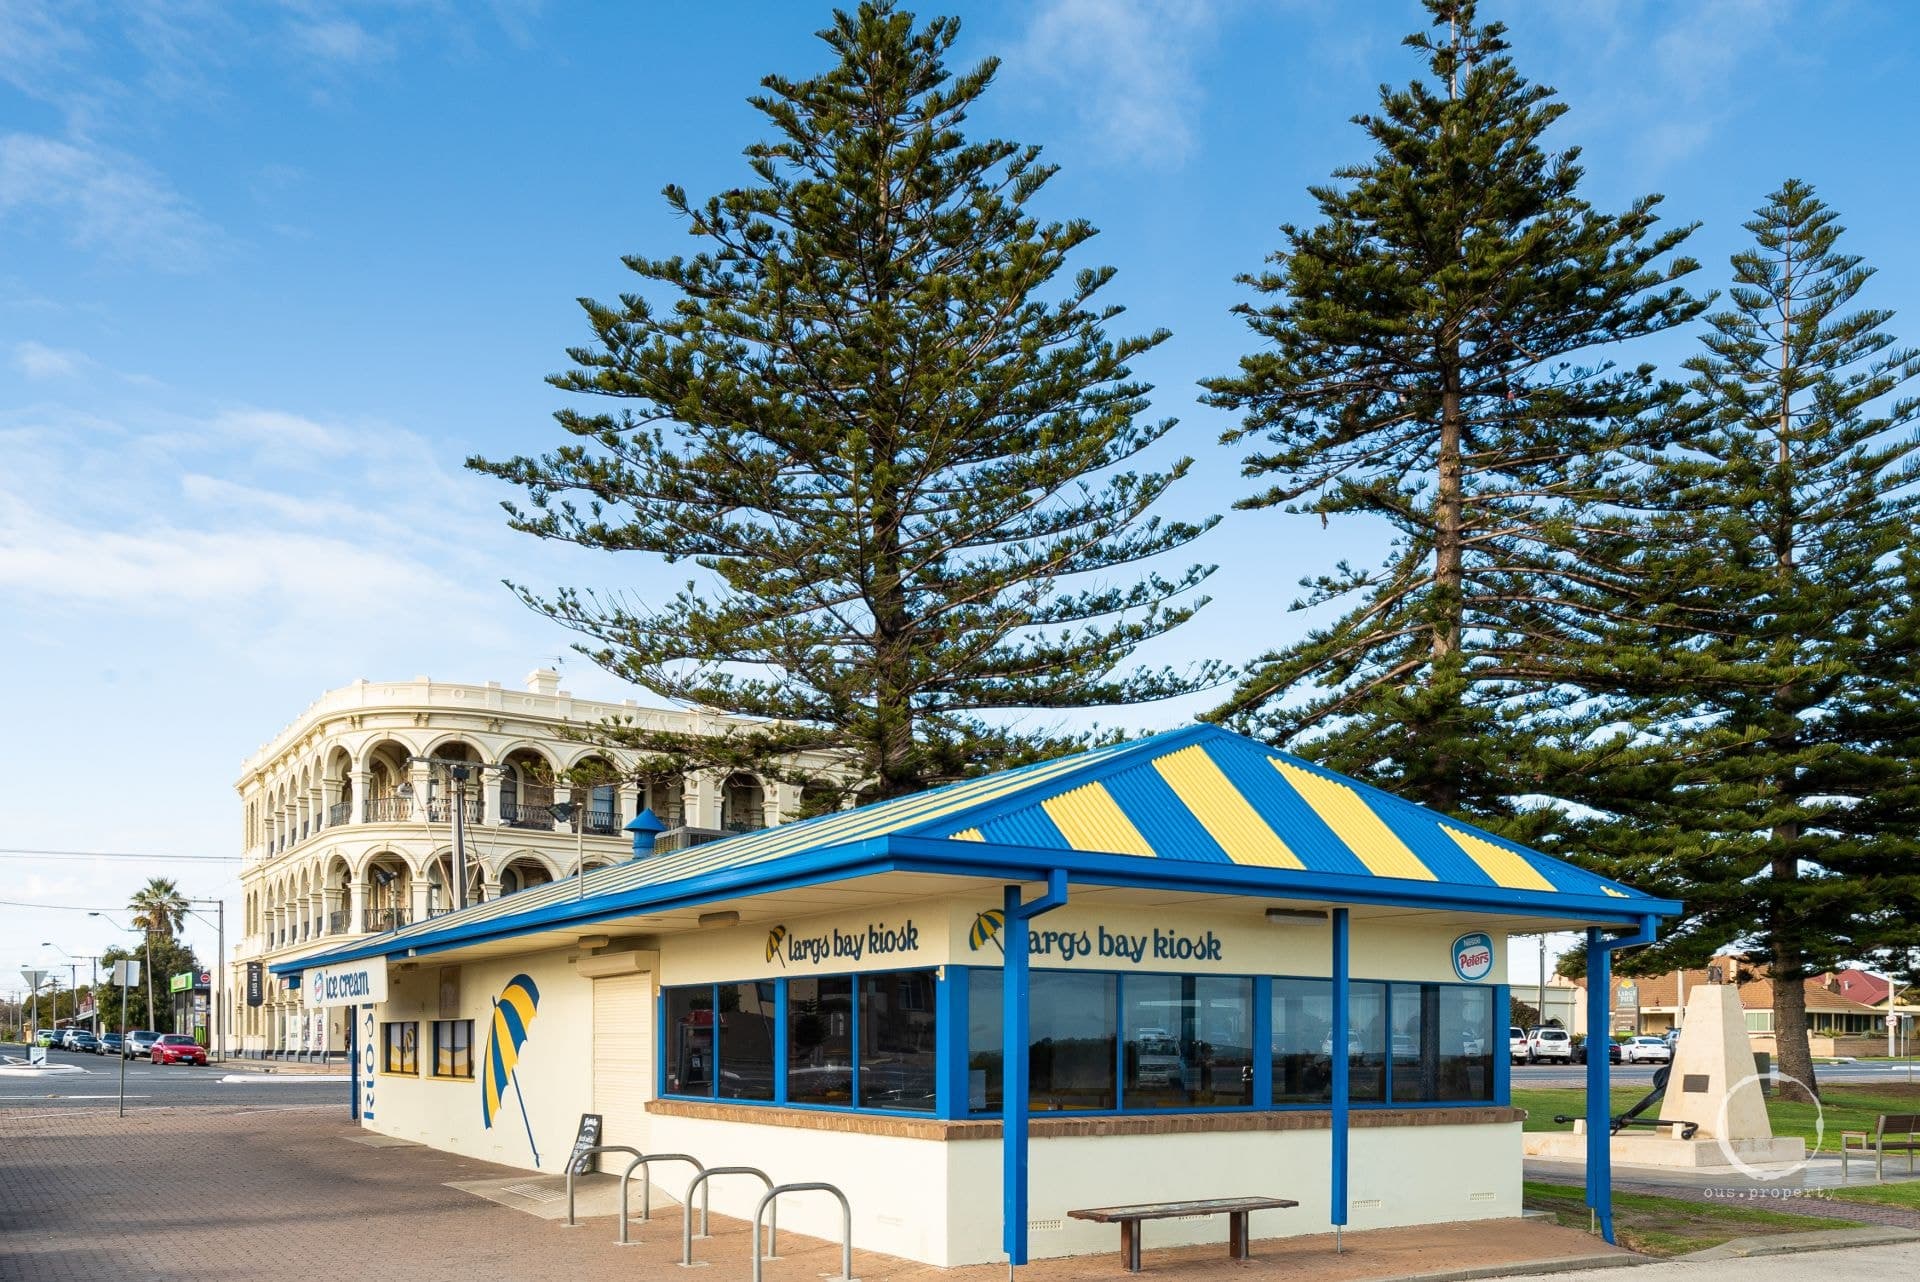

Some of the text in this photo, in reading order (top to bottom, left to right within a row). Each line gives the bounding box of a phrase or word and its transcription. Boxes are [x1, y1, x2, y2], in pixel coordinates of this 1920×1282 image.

[789, 920, 919, 964] largs bay kiosk
[1029, 926, 1222, 963] args bay kiosk
[1459, 951, 1489, 969] Peters
[325, 969, 370, 999] ice cream
